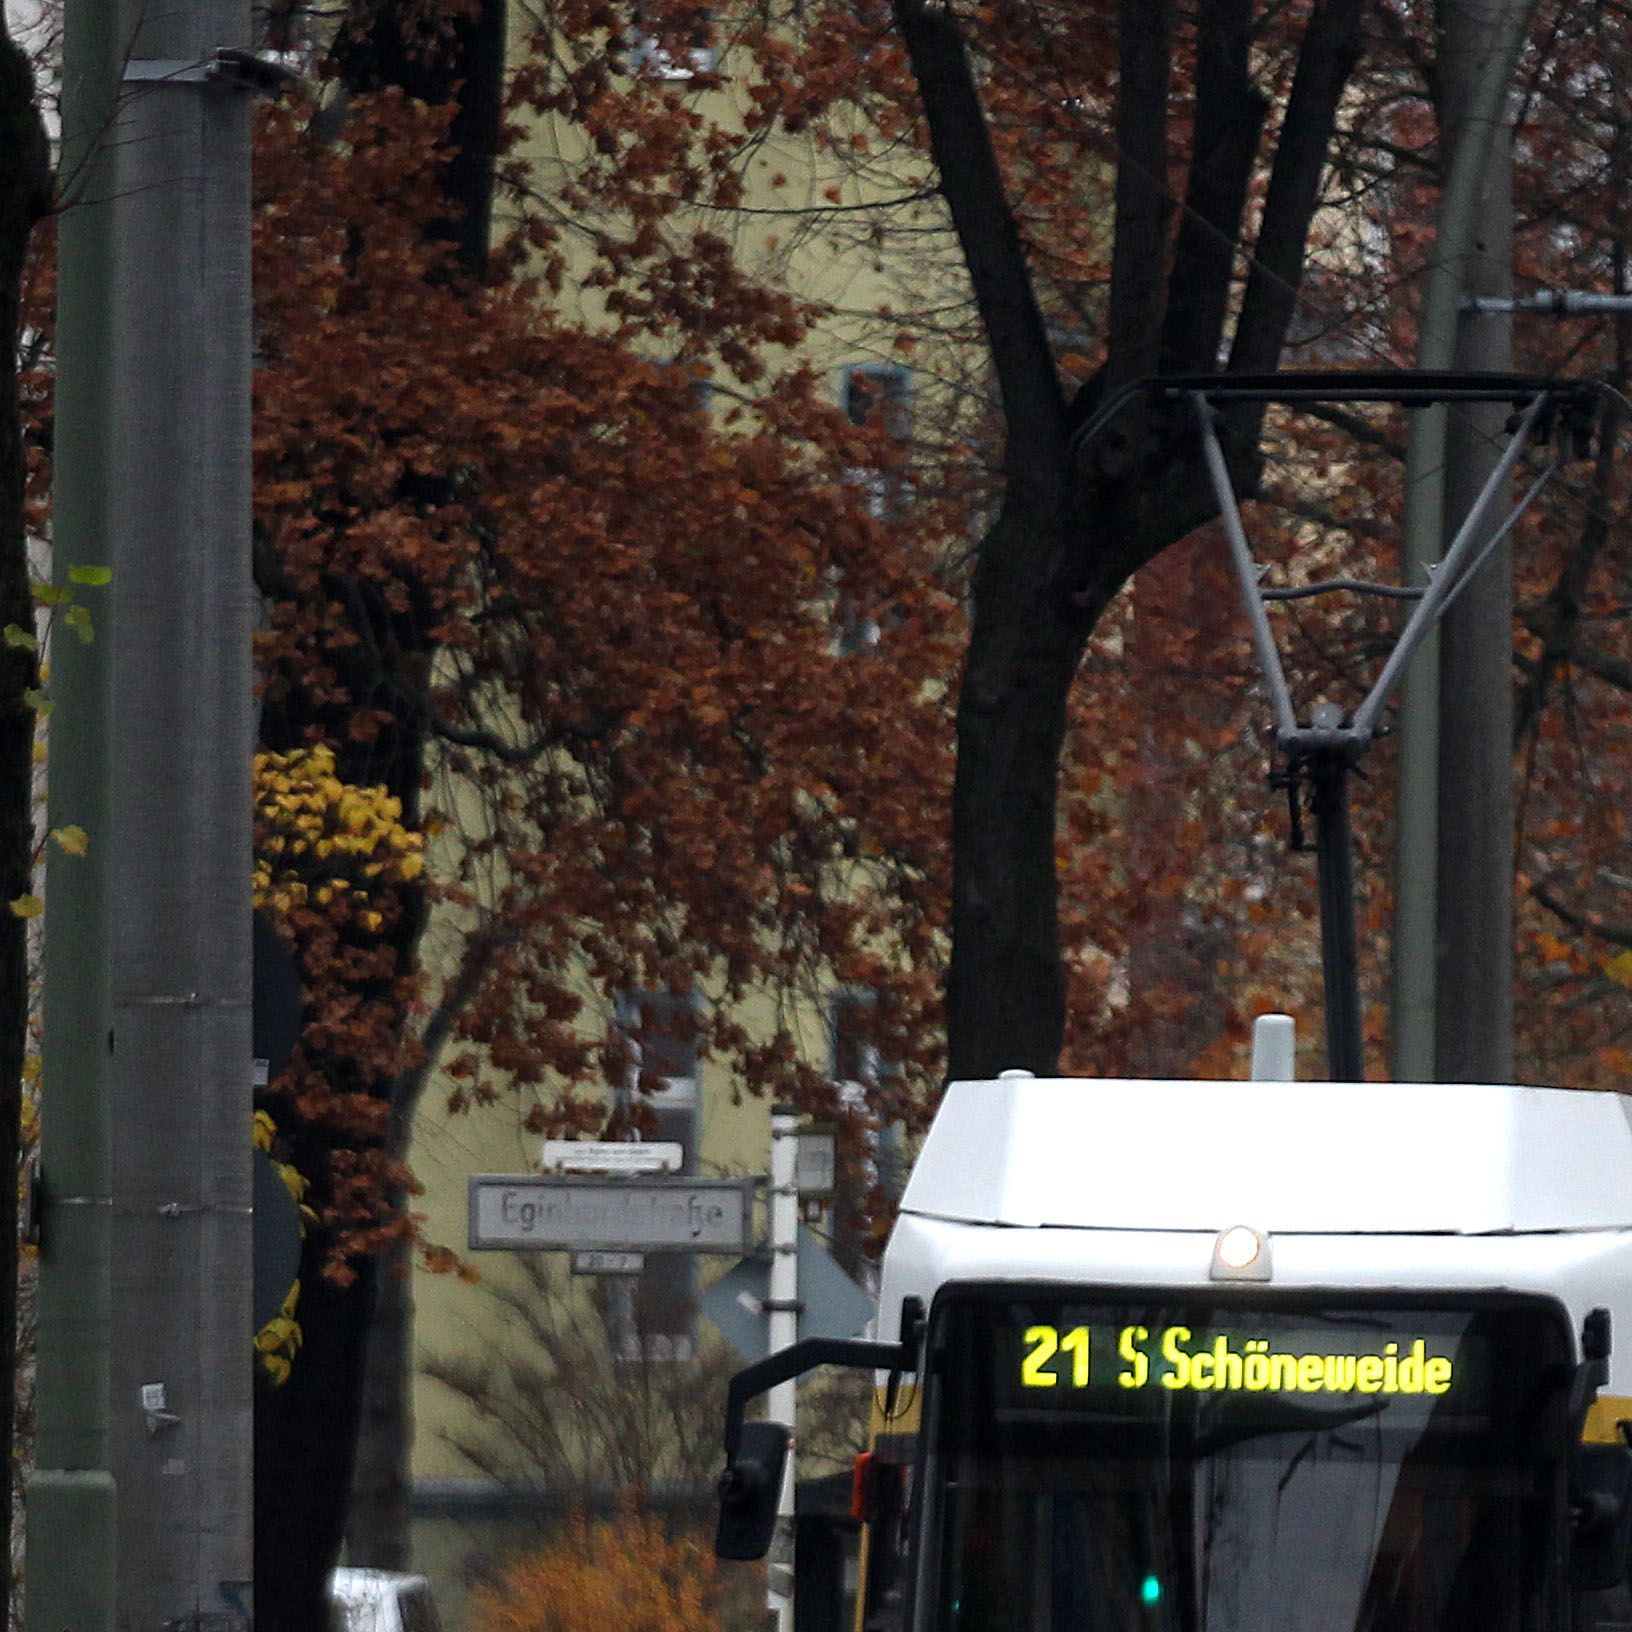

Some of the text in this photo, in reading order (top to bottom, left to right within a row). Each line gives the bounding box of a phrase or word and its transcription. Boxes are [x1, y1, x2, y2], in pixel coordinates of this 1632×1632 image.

[1021, 1325, 1453, 1395] 21 S Schöneweide
